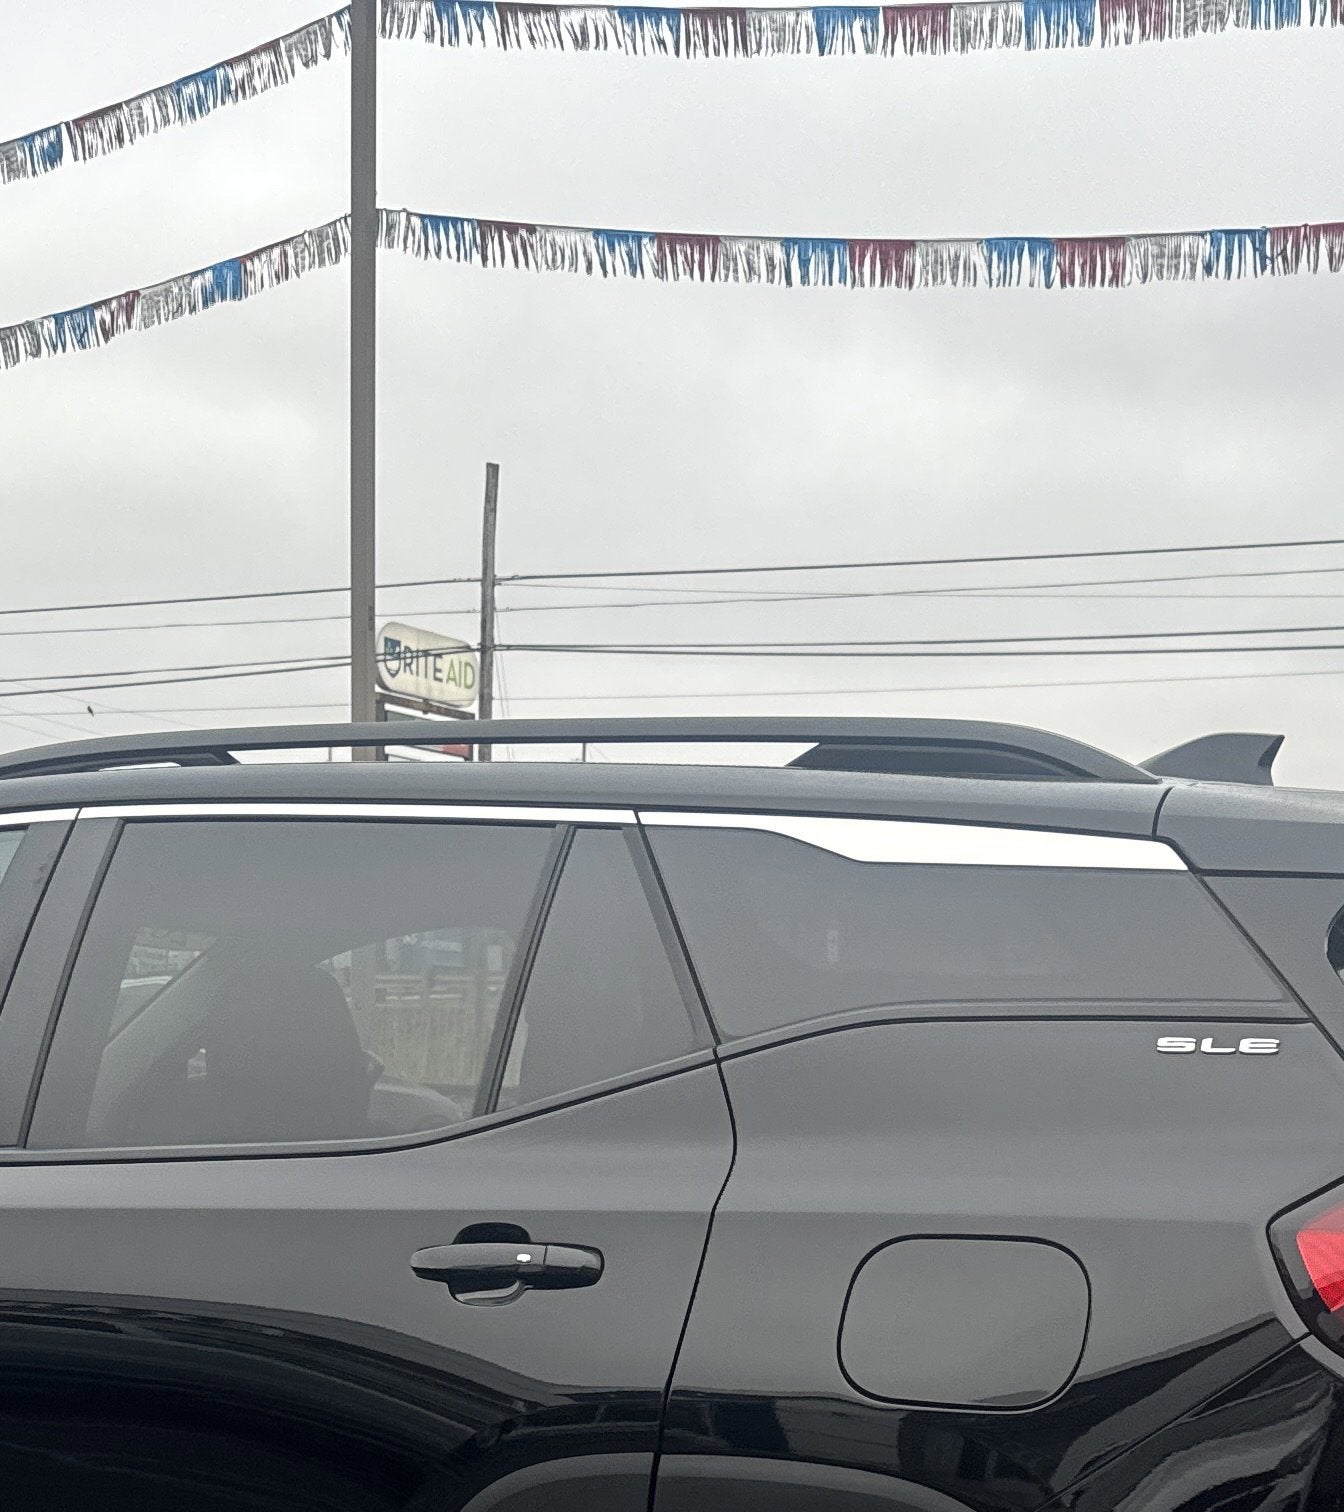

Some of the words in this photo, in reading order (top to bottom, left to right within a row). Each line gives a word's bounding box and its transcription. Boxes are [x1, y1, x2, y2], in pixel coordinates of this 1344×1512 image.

[403, 645, 443, 683] RITE
[446, 659, 476, 690] AID
[1156, 1036, 1280, 1055] SLE
